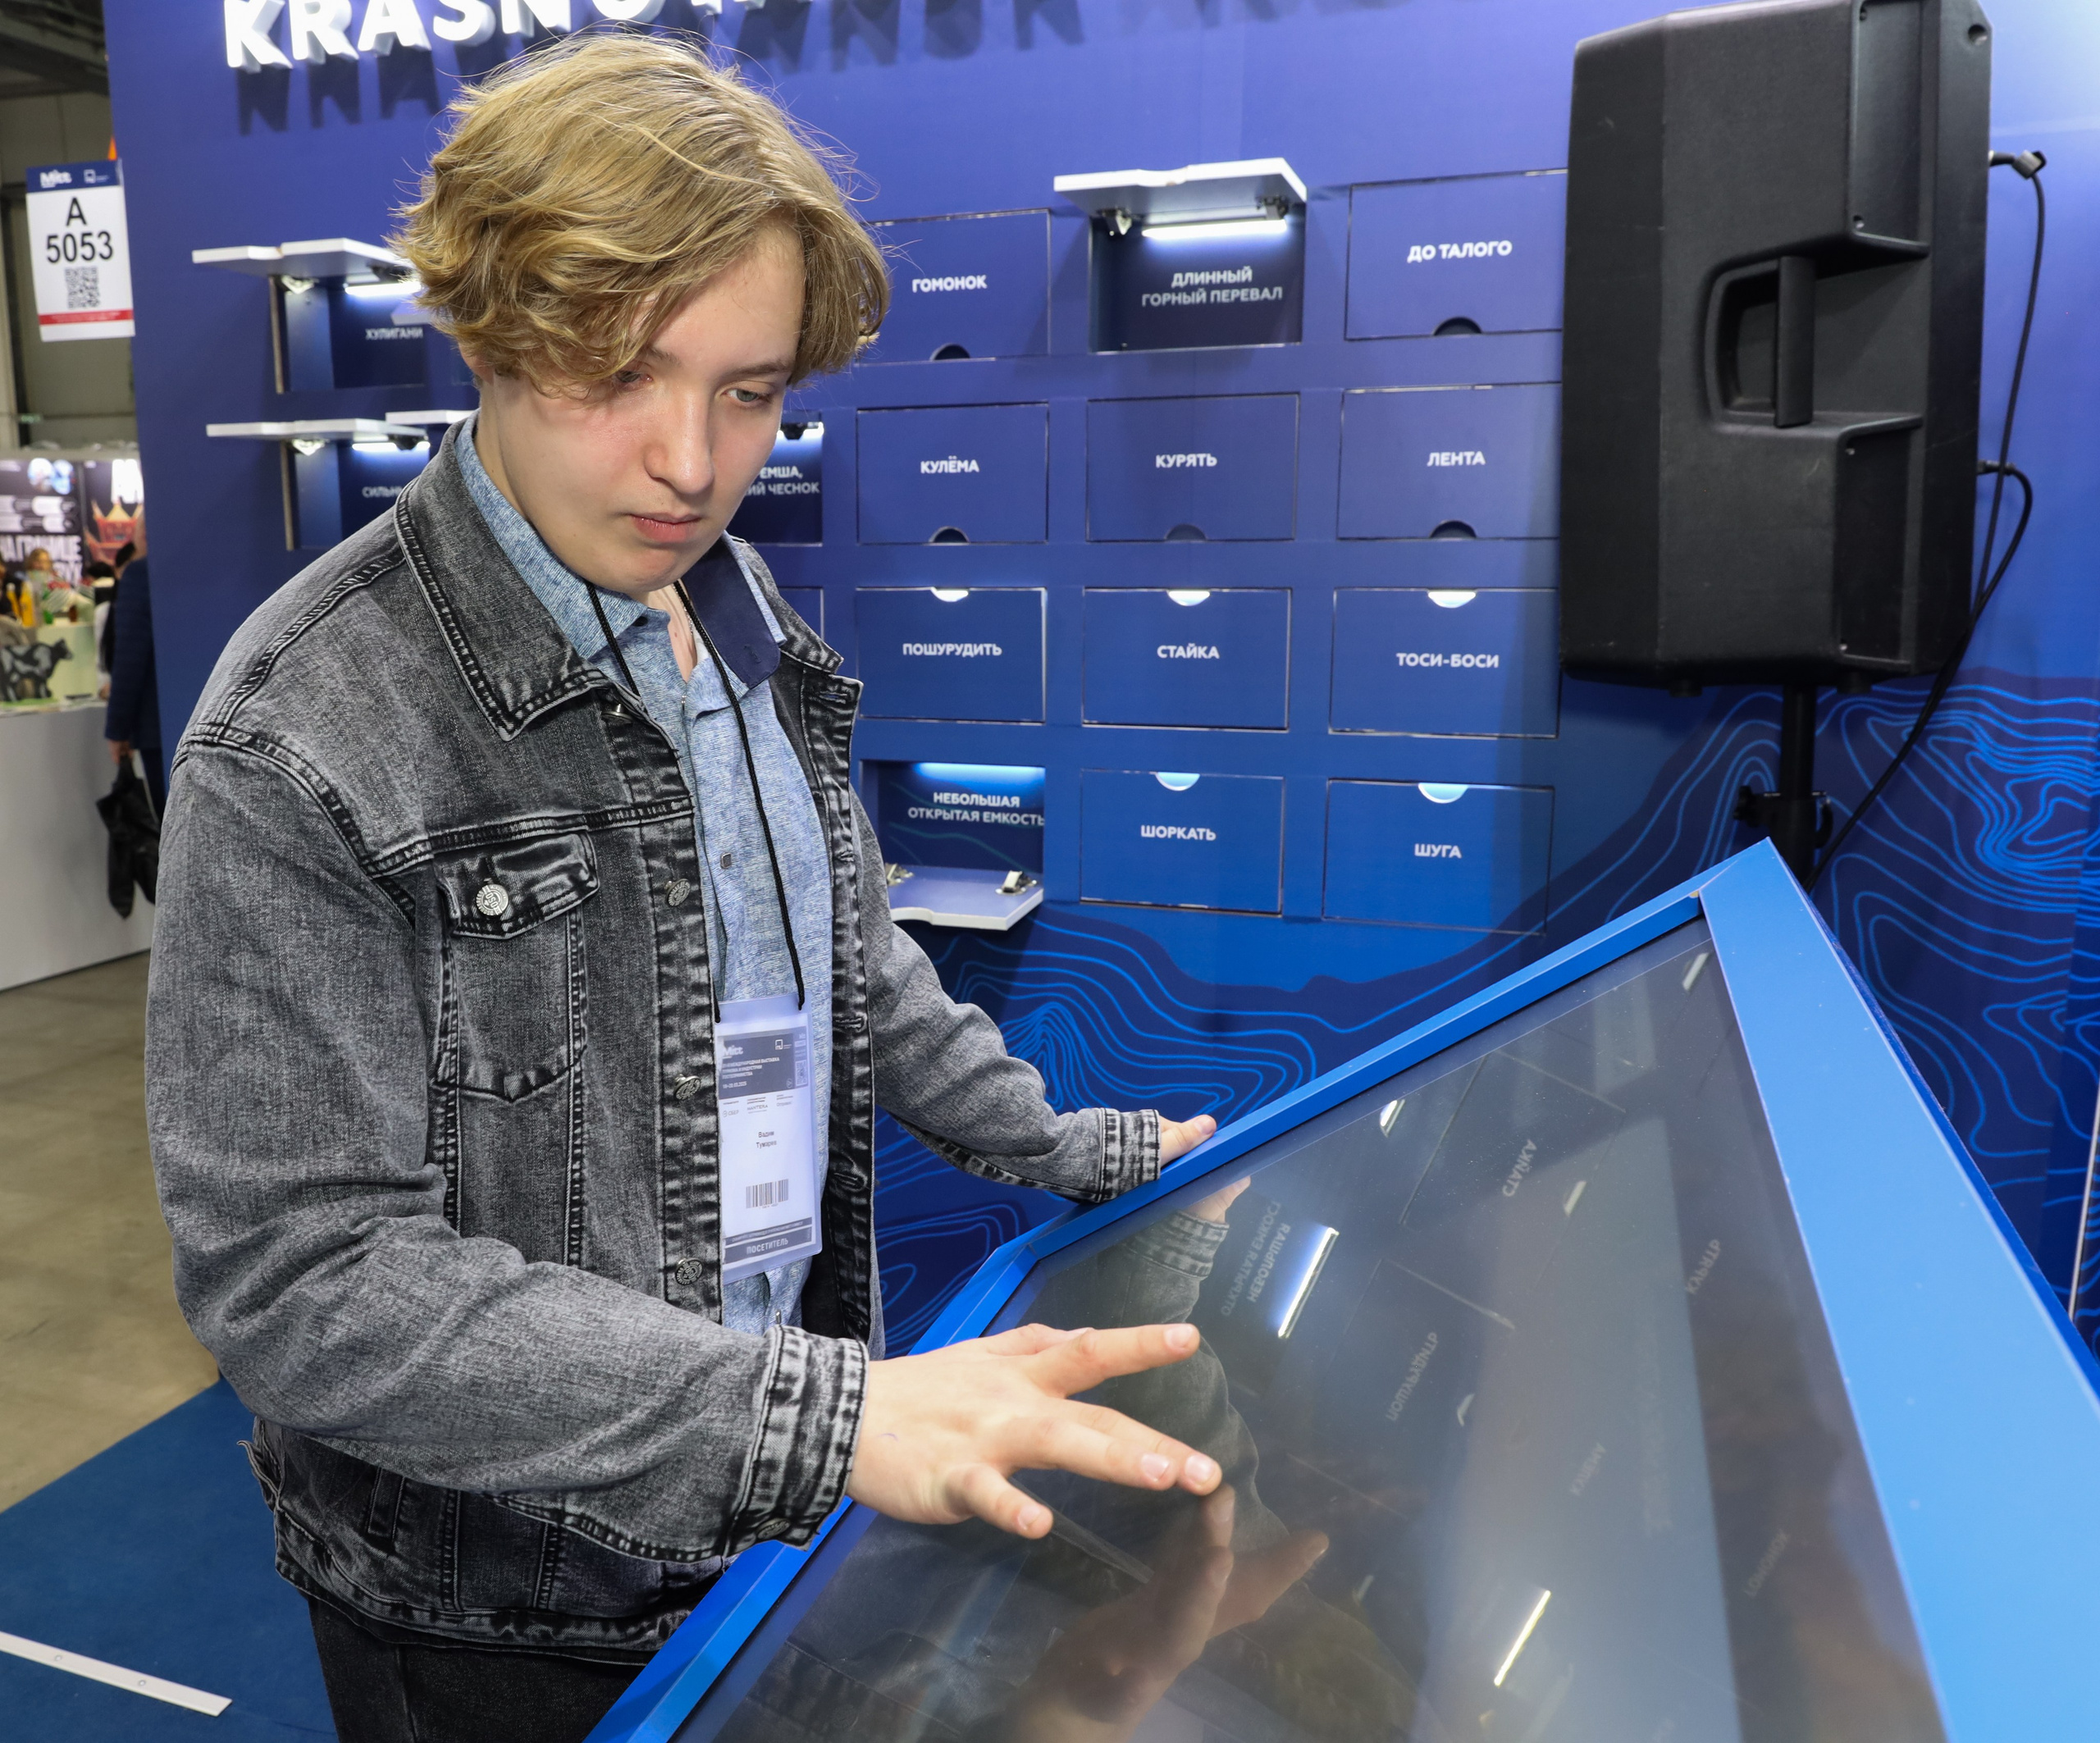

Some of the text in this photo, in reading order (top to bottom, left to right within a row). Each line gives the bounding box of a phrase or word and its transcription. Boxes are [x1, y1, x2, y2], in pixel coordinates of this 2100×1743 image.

[46, 230, 113, 264] 5053
[1407, 240, 1513, 263] ДО ТАЛОГО
[911, 274, 988, 293] ГОМОНОК
[1171, 266, 1253, 287] ДЛИННЫЙ
[1142, 286, 1283, 307] ГОРНЫЙ ПЕРЕВАЛ
[920, 455, 979, 474] КУЛЁМА
[1155, 453, 1217, 469] КУРЯТЬ
[1427, 450, 1486, 467] ЛЕНТА
[745, 481, 819, 495] ИЙ ЧЕСНОК
[902, 643, 1002, 658] ПОШУРУДИТЬ
[1157, 642, 1220, 659] СТАЙКА
[1395, 652, 1500, 668] ТОСИ-БОСИ
[934, 792, 1020, 808] НЕБОЛЬШАЯ
[908, 807, 979, 822] ОТКРЫТАЯ
[1140, 824, 1217, 841] ШОРКАТЬ
[1414, 843, 1462, 859] ШУГА
[746, 1238, 789, 1255] ПОСЕТИТЕЛЬ
